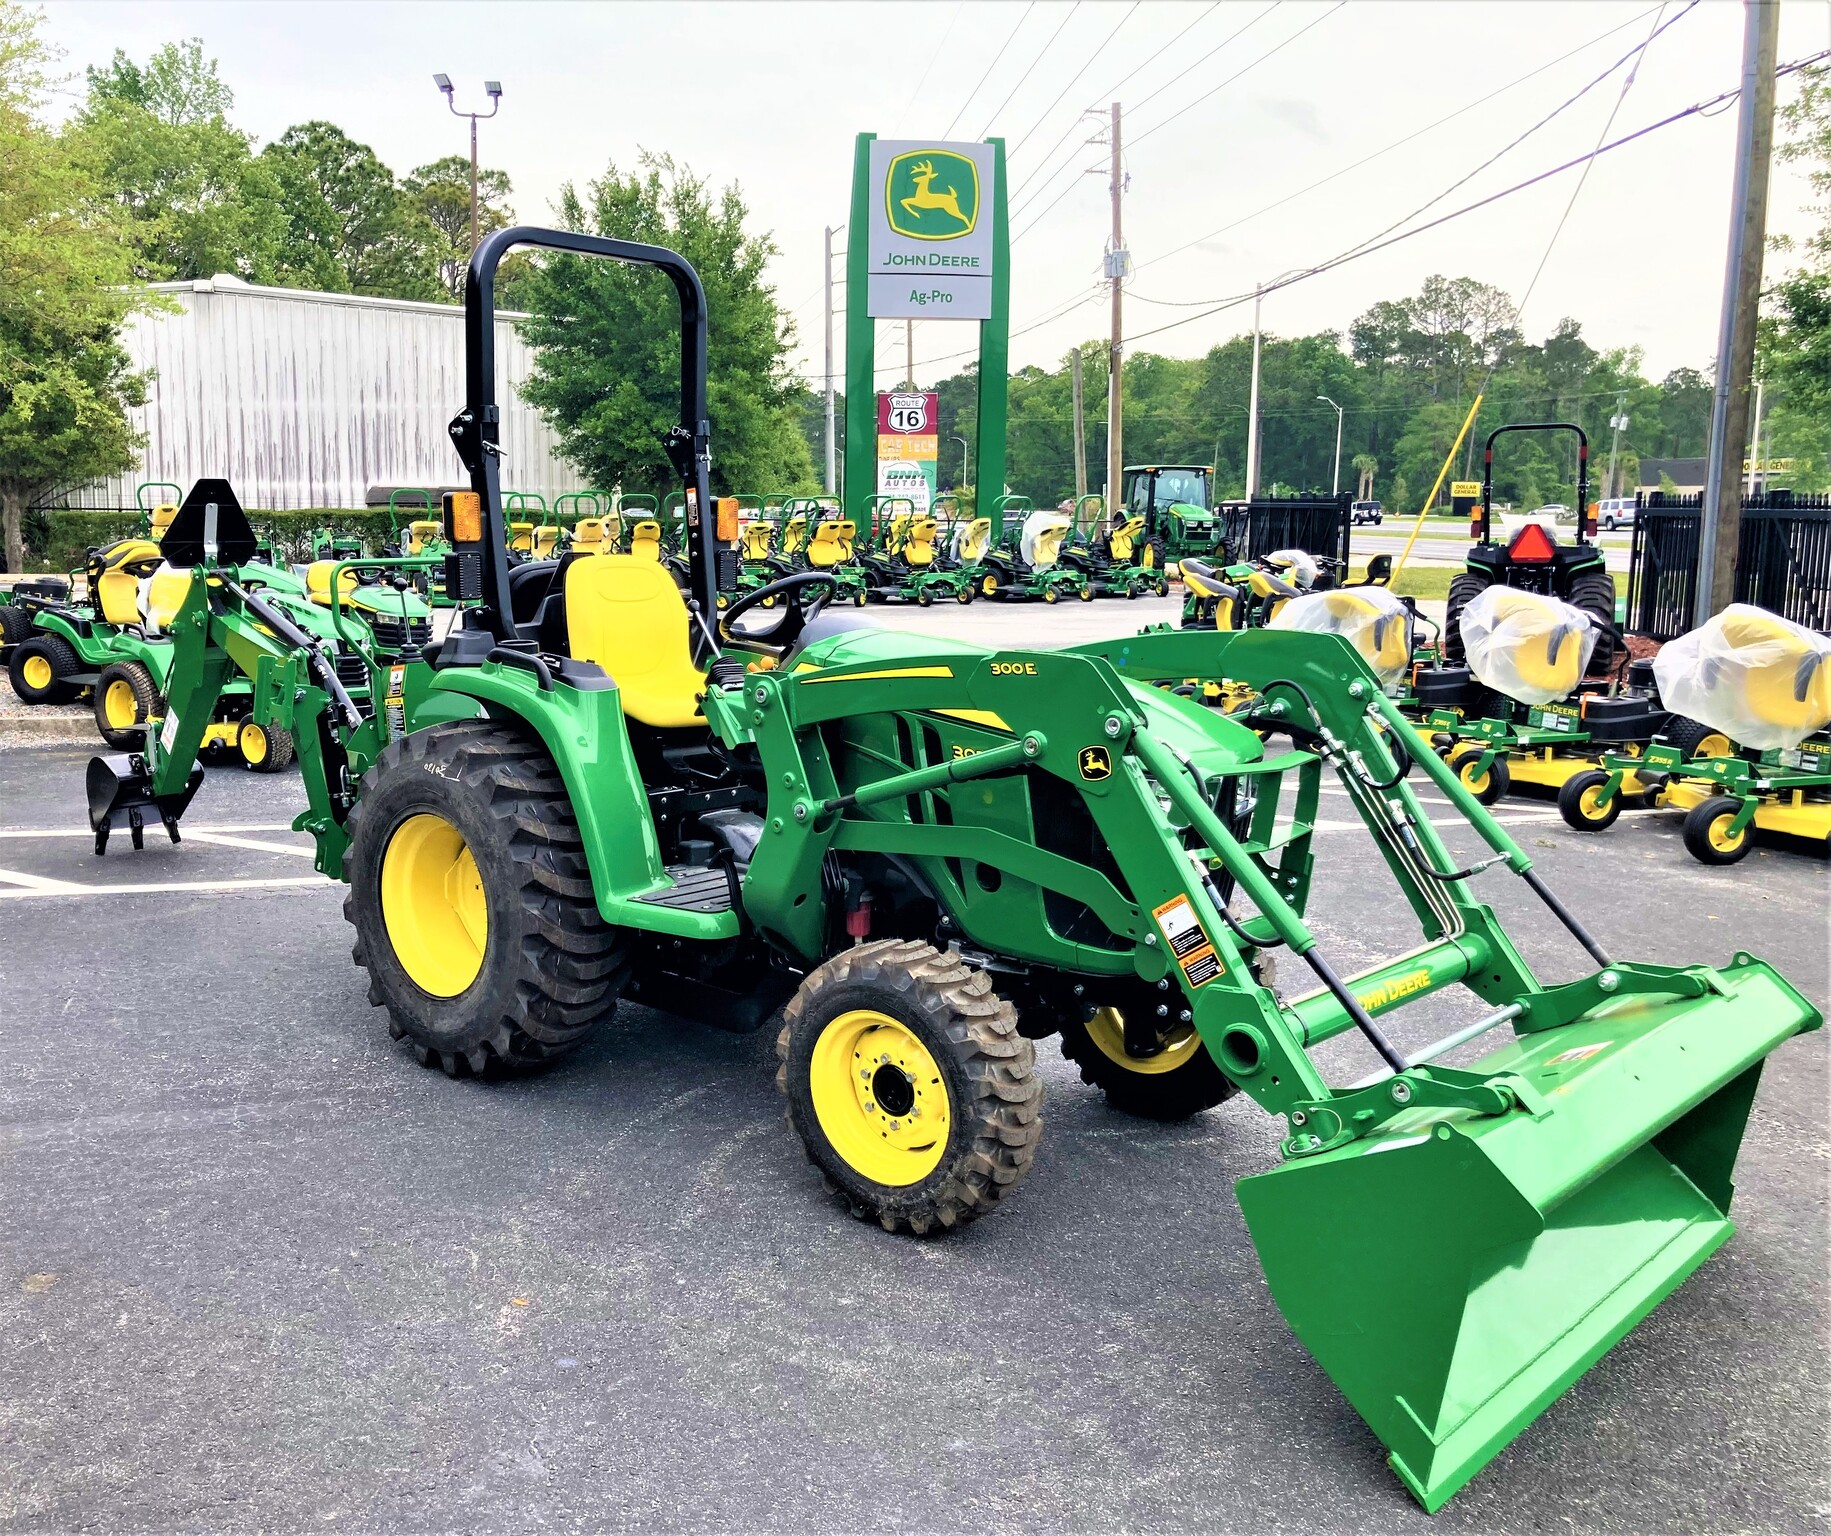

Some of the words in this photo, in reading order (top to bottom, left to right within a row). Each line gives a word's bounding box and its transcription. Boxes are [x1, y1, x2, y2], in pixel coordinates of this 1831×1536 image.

[883, 253, 926, 266] JOHN
[929, 253, 979, 267] DEERE
[909, 289, 953, 305] Ag-Pro
[895, 410, 919, 427] 16
[886, 470, 926, 480] BNM
[1552, 705, 1579, 717] DEERE
[1162, 898, 1183, 912] WARNING
[1189, 949, 1210, 962] WARNING
[1357, 988, 1387, 1011] OHN
[1383, 969, 1431, 1000] DEERE
